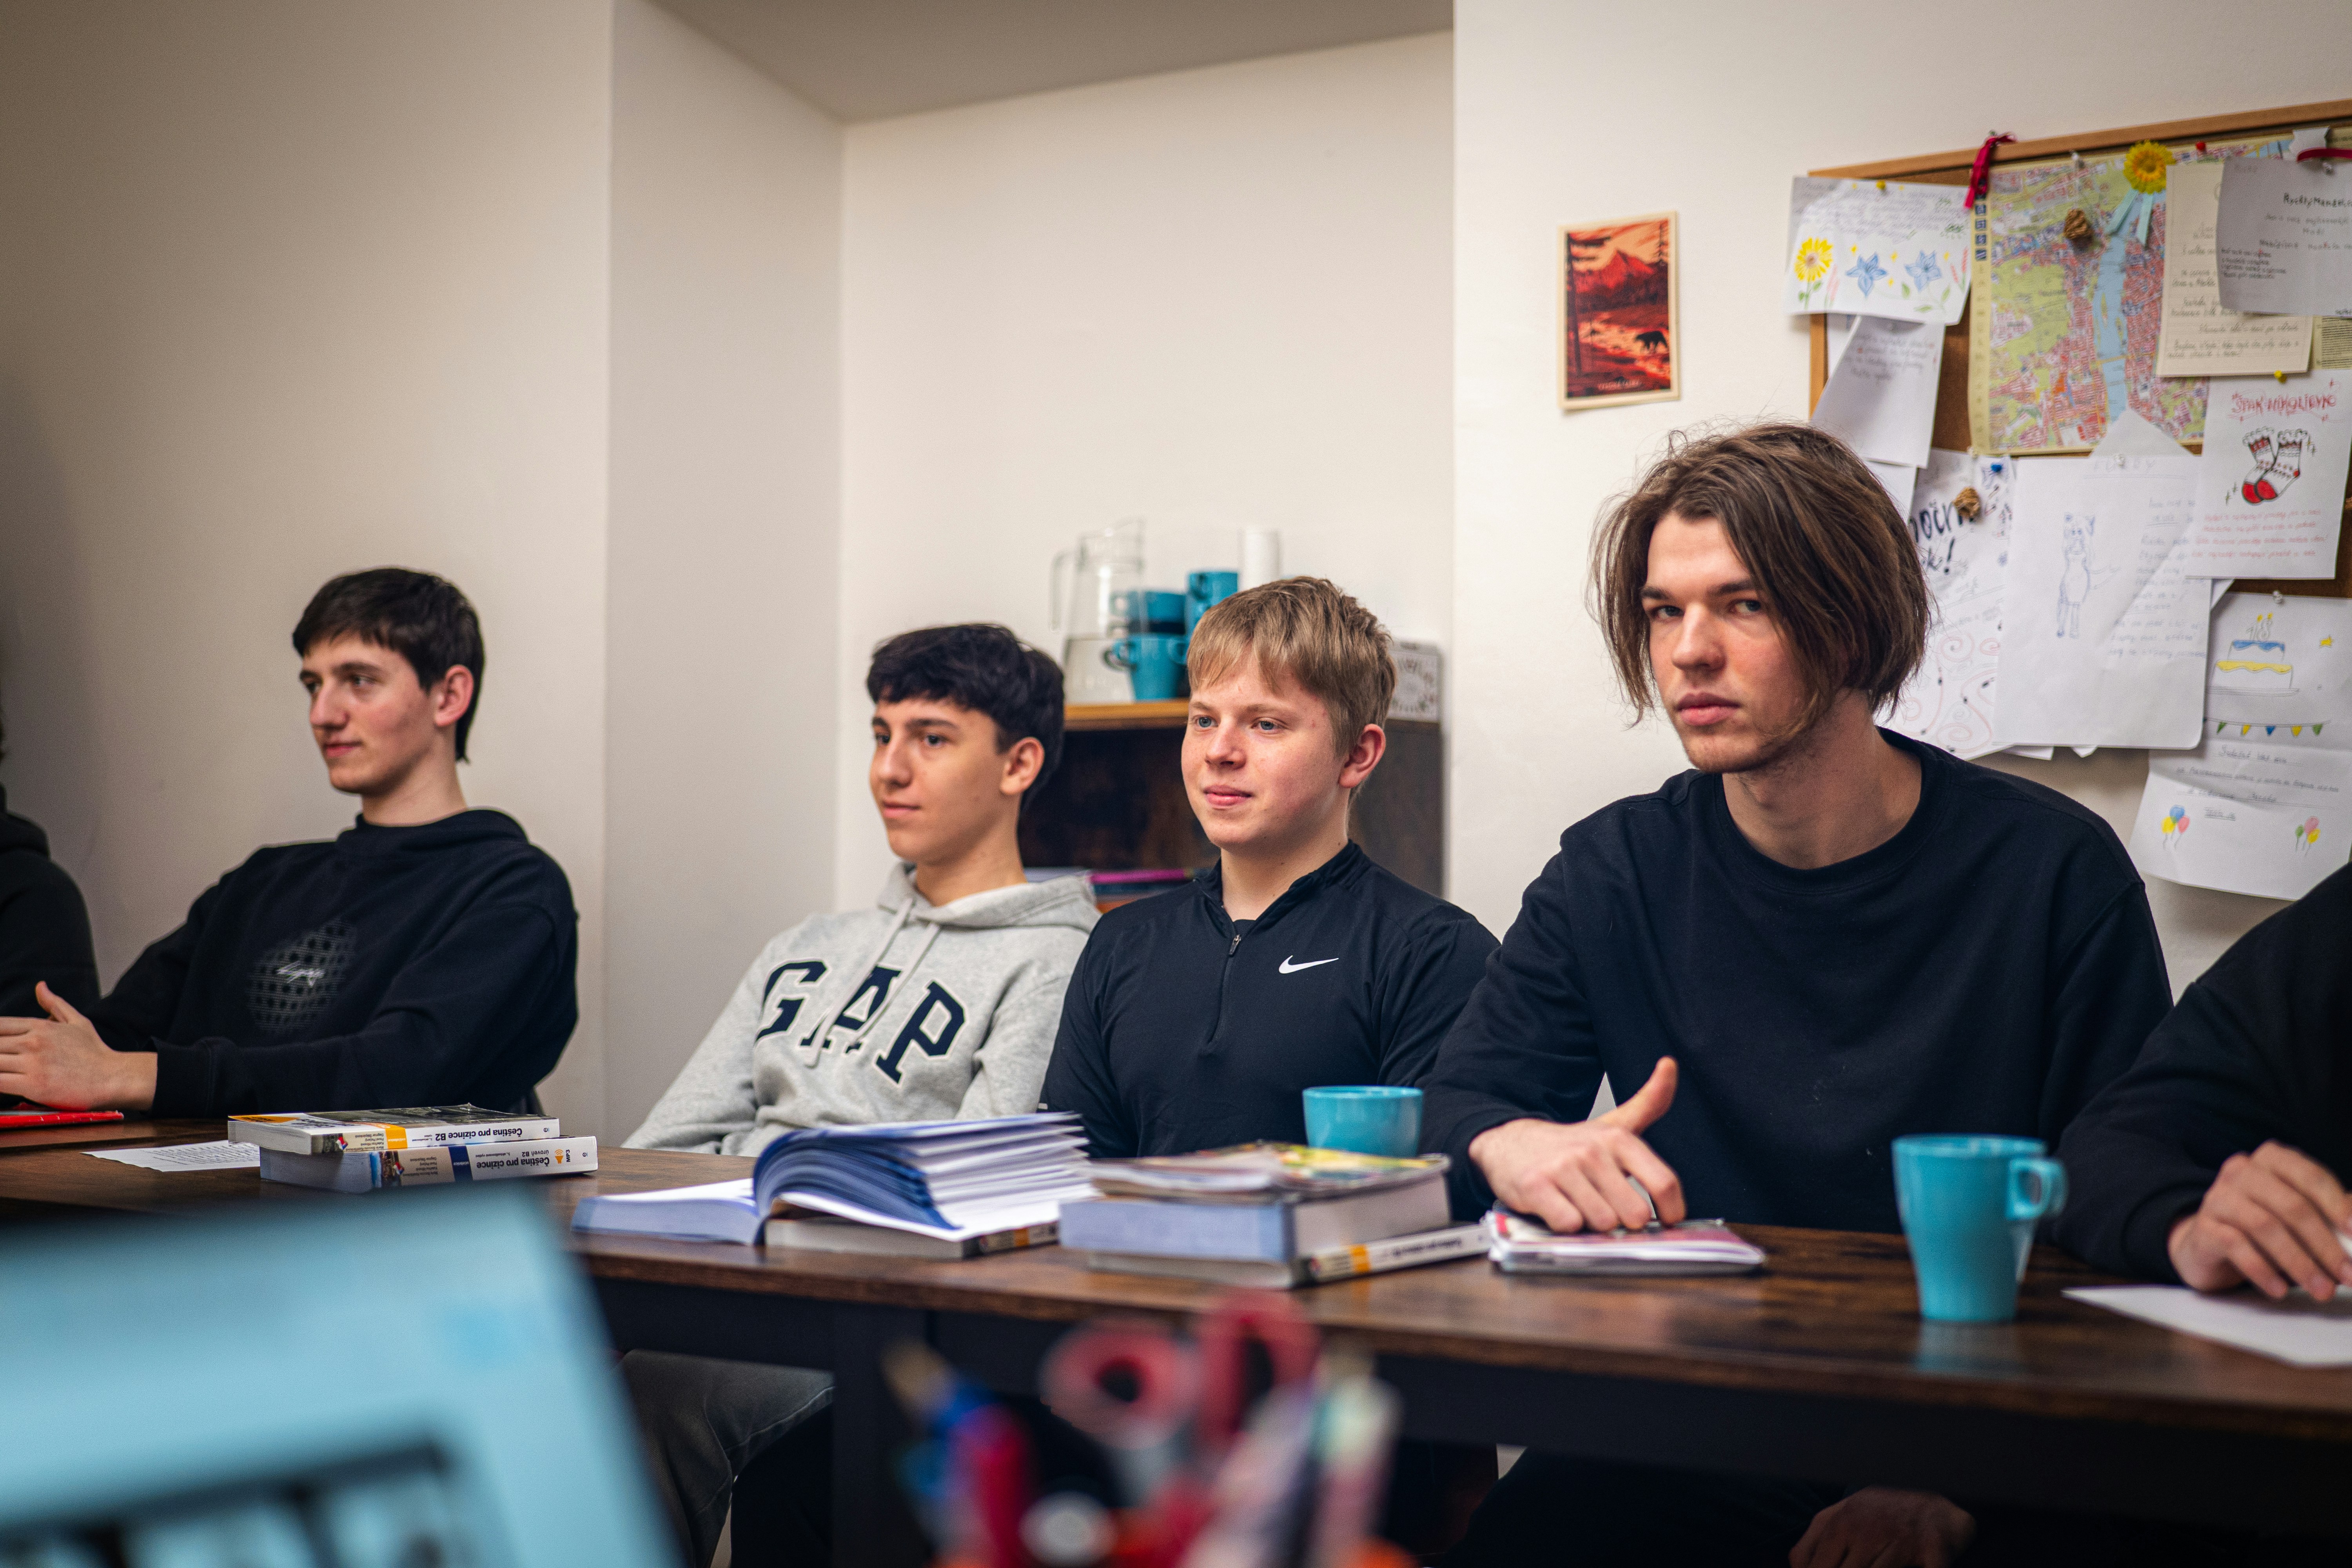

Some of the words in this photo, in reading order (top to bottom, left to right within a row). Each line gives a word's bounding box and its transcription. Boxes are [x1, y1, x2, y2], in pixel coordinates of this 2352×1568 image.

[754, 958, 966, 1087] GAP
[435, 1132, 446, 1141] B2
[448, 1131, 476, 1140] cizince
[478, 1129, 491, 1138] pro
[493, 1127, 523, 1138] Čeština
[476, 1160, 505, 1169] cizince
[506, 1158, 518, 1166] pro
[521, 1157, 550, 1167] Čeština
